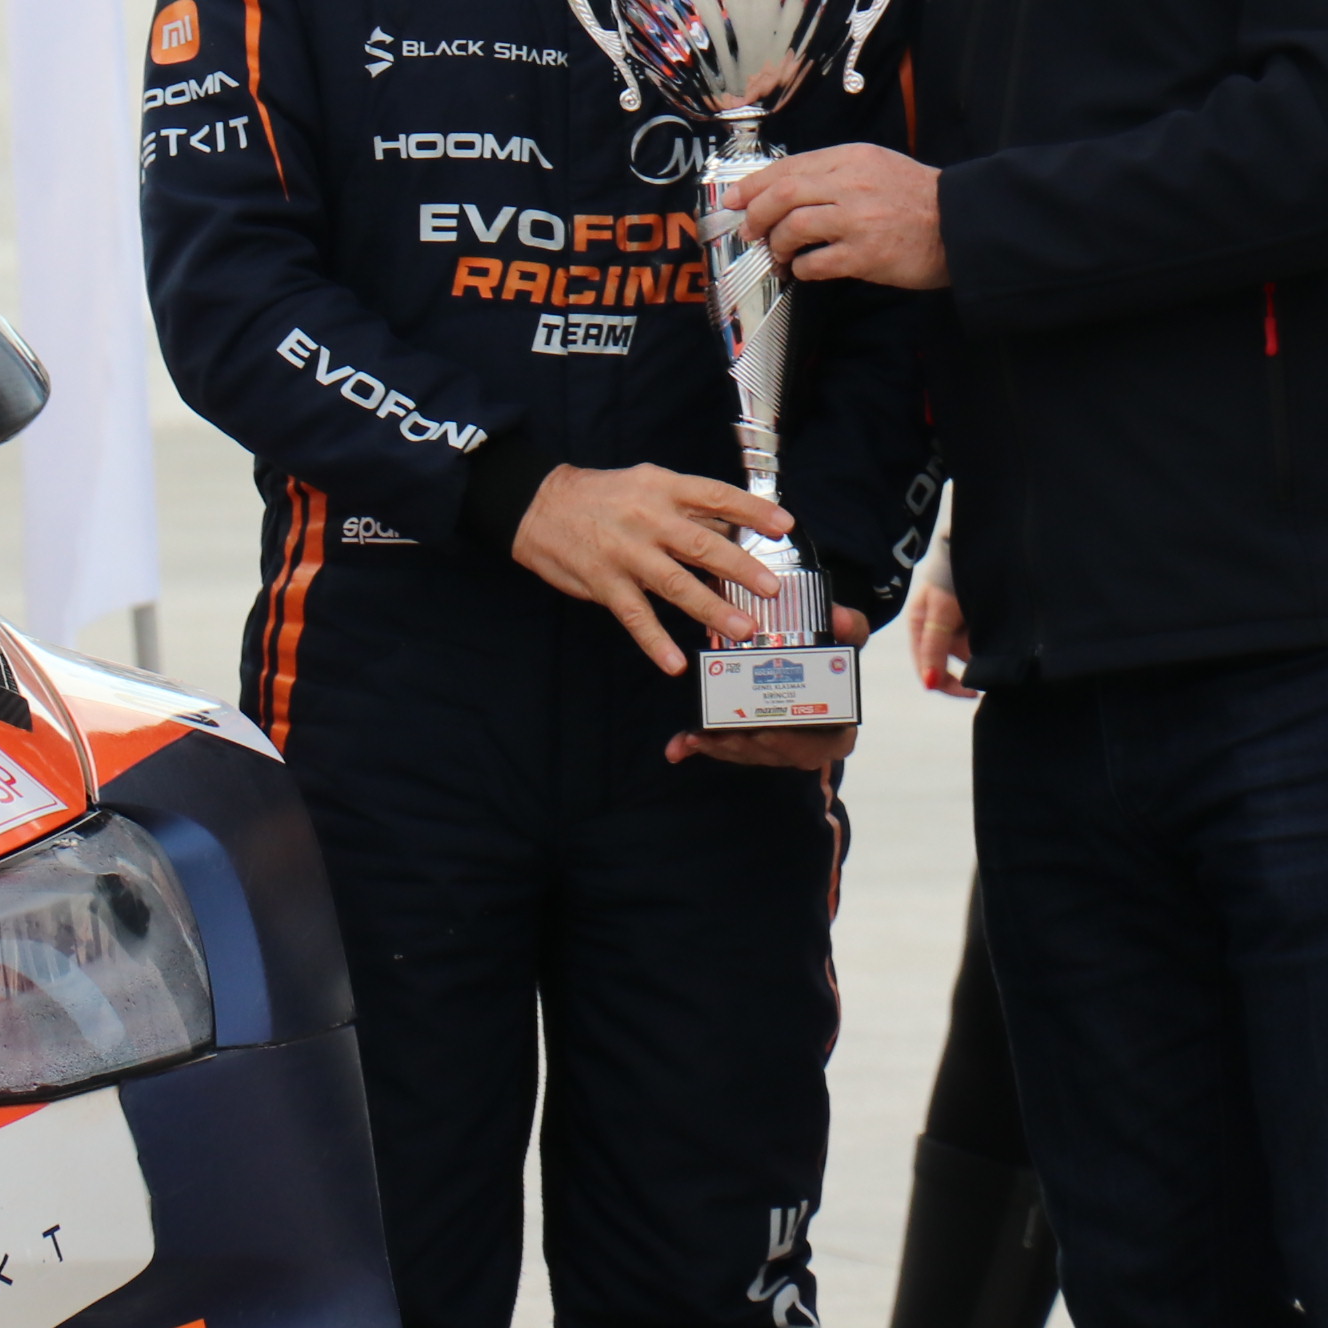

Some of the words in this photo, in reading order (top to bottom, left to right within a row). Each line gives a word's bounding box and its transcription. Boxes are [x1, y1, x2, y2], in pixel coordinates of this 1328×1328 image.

[402, 39, 486, 57] BLACK
[493, 42, 569, 68] SHARK
[373, 132, 555, 171] HOOMA
[419, 203, 701, 252] EVOFON
[450, 255, 709, 308] RACING
[537, 318, 633, 351] TEAM
